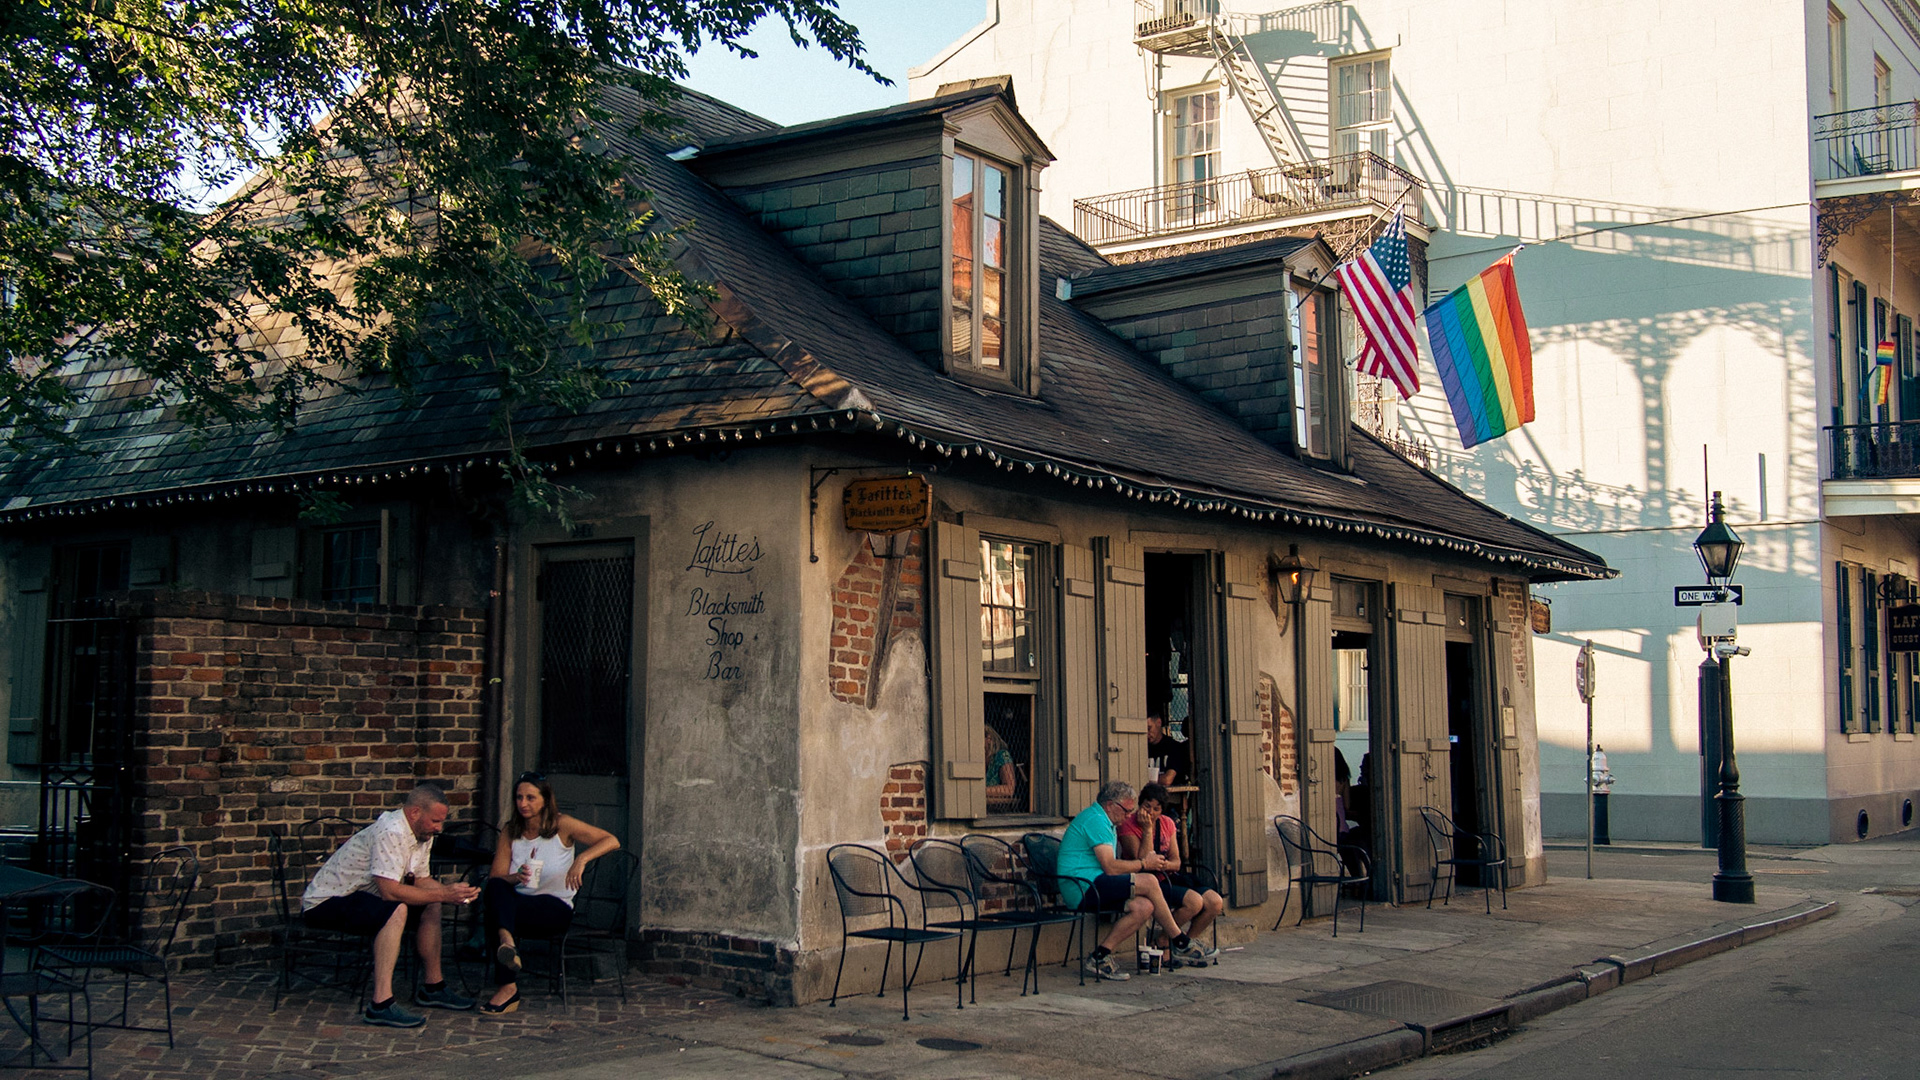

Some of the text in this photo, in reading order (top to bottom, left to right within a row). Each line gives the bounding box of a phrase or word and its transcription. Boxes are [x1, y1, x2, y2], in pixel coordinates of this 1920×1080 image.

[857, 485, 912, 504] Lafitte's
[849, 503, 922, 518] Blacksmith Shop
[686, 521, 766, 577] Lafitte's
[685, 587, 766, 616] Blacksmith
[1681, 592, 1716, 601] ONE WA
[706, 617, 744, 650] Shop
[1893, 615, 1920, 629] LAF
[703, 651, 742, 680] Bar
